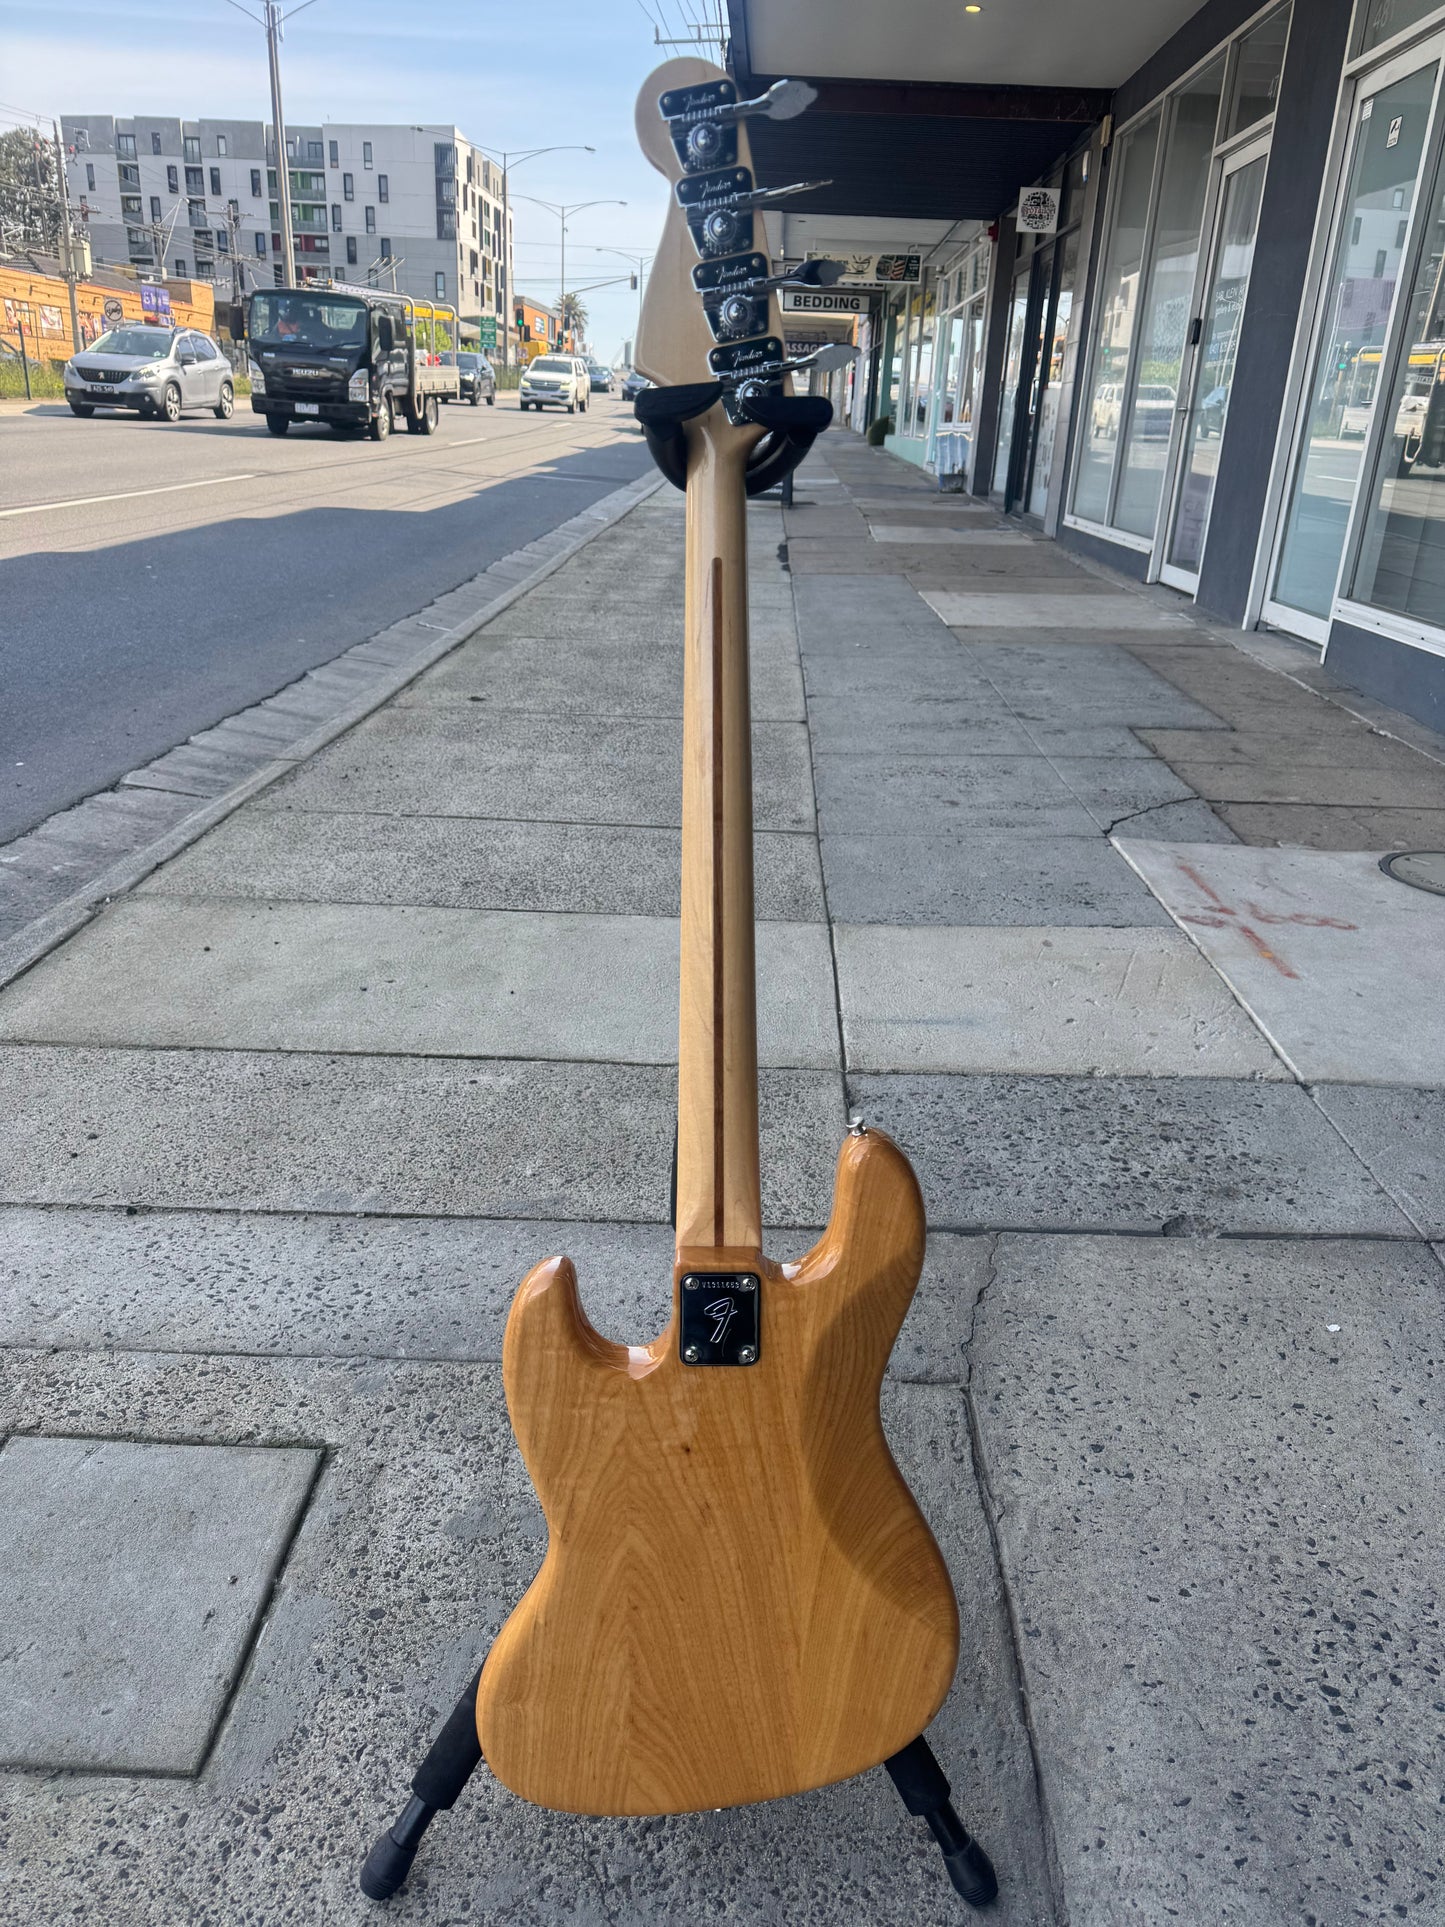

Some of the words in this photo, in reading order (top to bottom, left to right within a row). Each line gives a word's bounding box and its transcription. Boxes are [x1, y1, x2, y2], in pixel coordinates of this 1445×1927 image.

[683, 93, 716, 111] Fender
[699, 180, 732, 199] Fender
[715, 265, 747, 283] Fender
[793, 295, 861, 310] BEDDING
[731, 349, 763, 367] Fender
[292, 368, 319, 376] ISUZU
